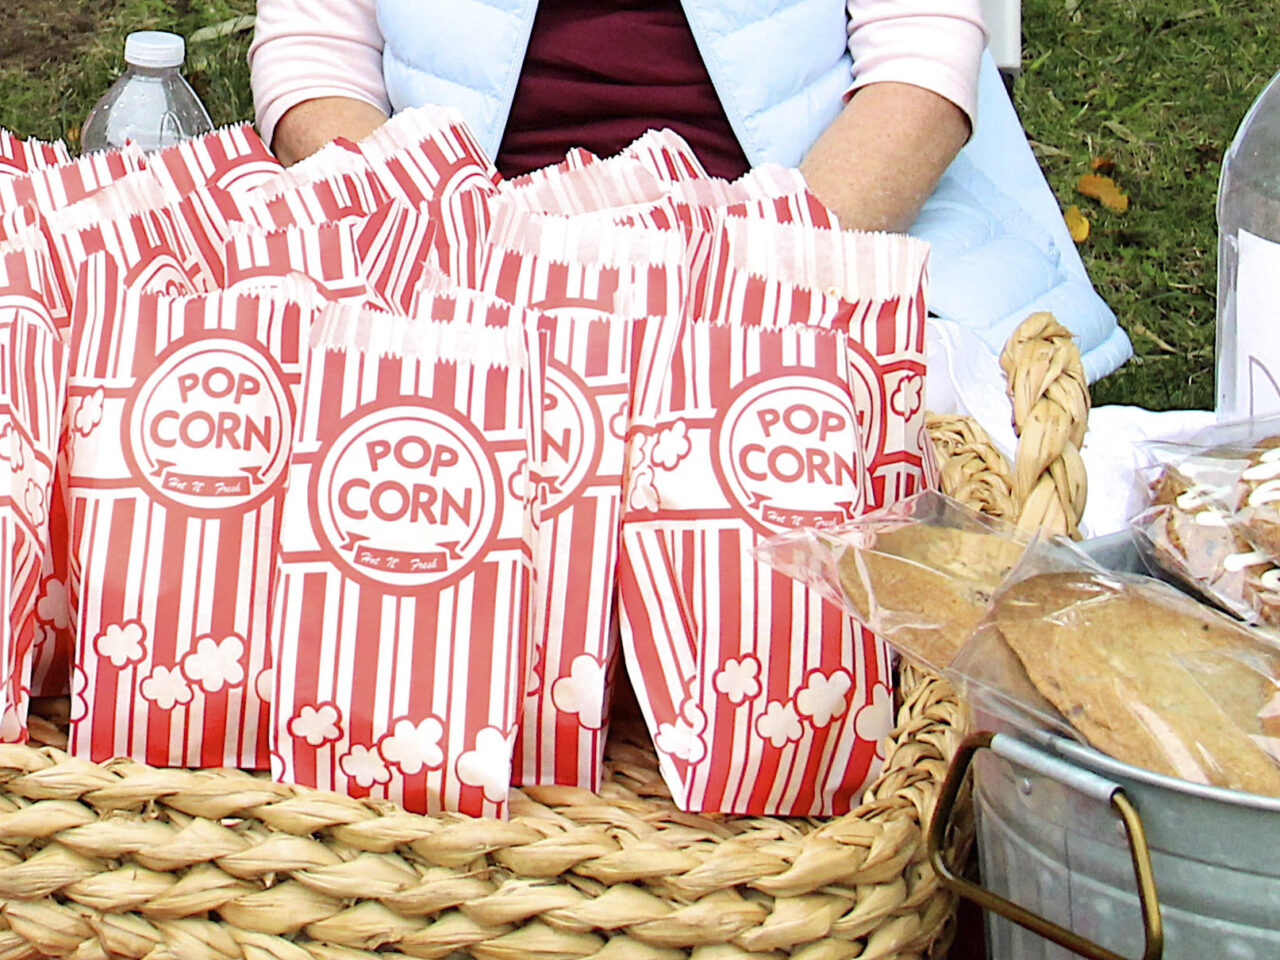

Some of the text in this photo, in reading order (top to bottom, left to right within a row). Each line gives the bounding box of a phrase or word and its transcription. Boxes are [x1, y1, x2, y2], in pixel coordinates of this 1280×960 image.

[178, 367, 260, 405] POP
[150, 410, 271, 454] CORN
[757, 403, 846, 442] POP
[366, 435, 459, 477] POP
[739, 443, 857, 489] CORN
[338, 478, 472, 527] CORN
